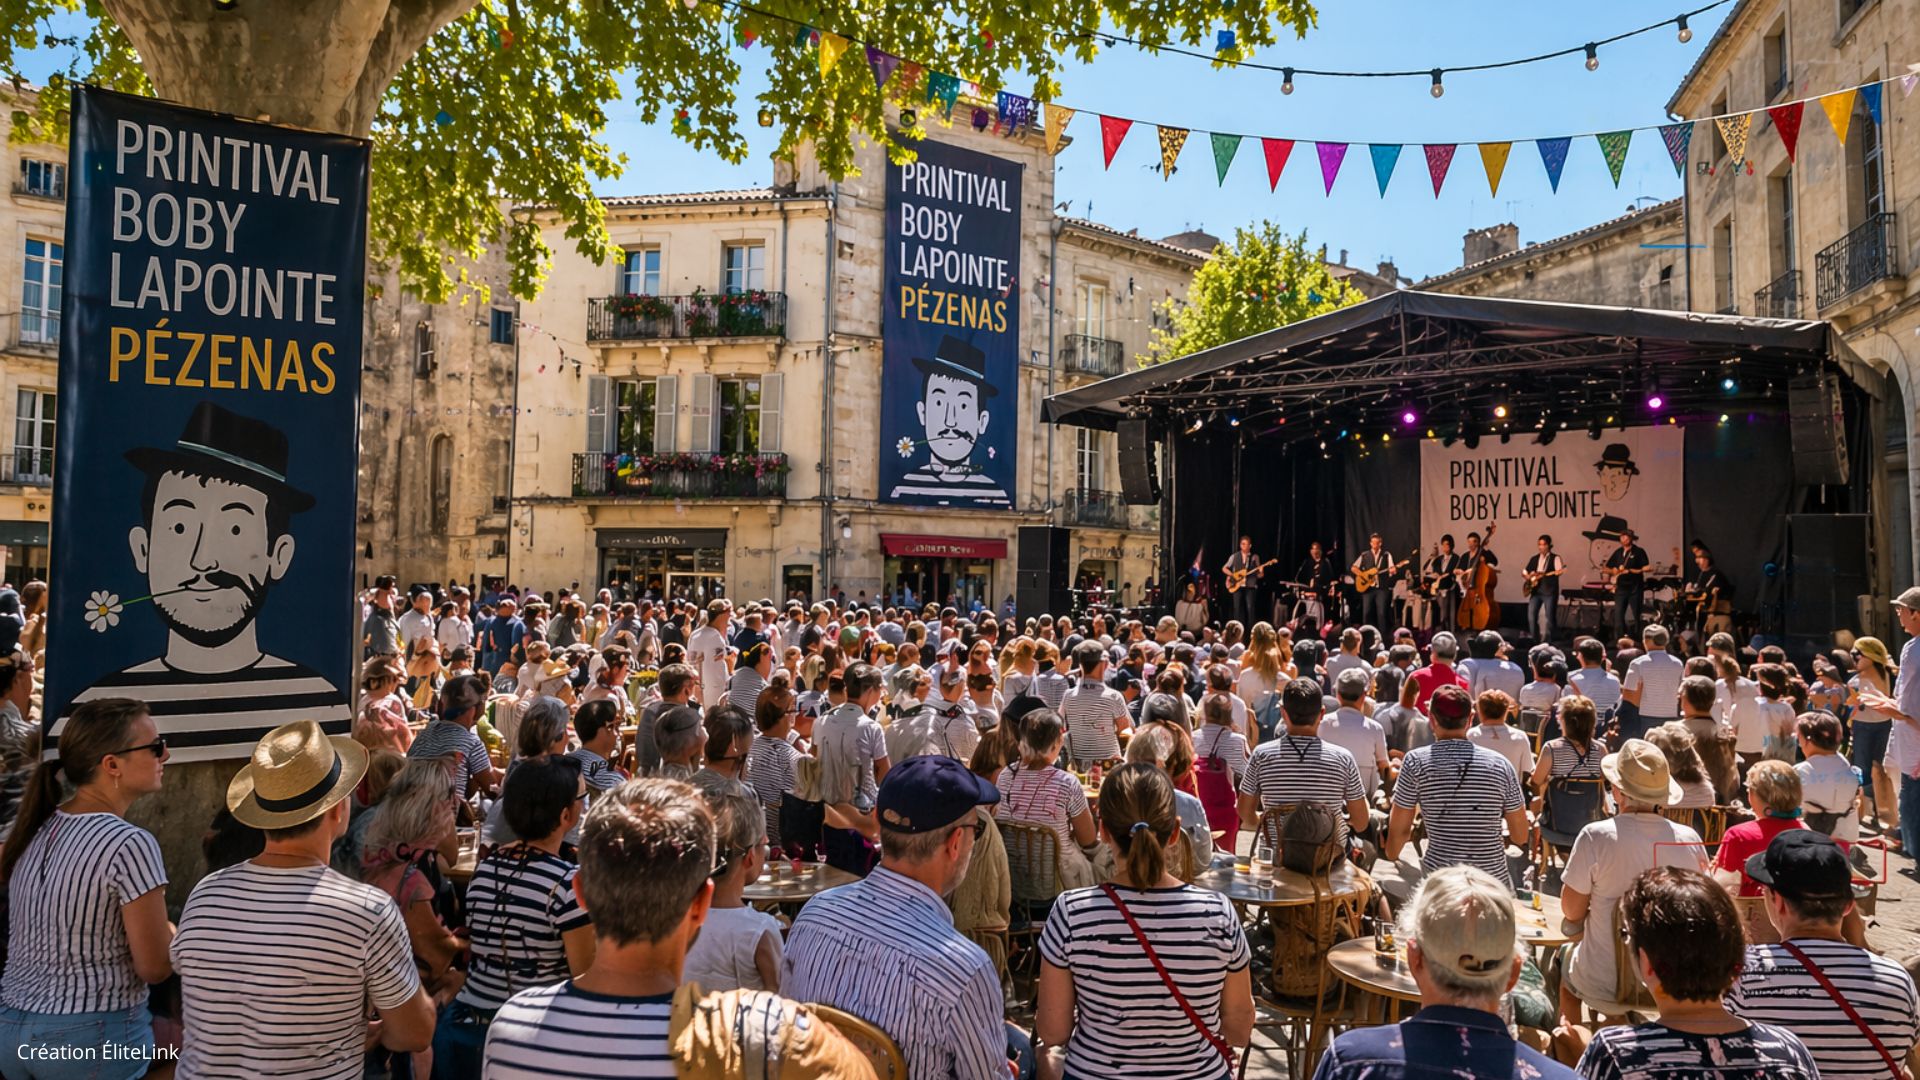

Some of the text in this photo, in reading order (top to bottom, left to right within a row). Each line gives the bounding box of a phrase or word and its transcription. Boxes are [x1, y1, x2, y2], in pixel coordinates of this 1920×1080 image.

[115, 119, 340, 205] PRINTIVAL
[901, 161, 1012, 213] PRINTIVAL
[113, 186, 247, 254] BOBY
[900, 202, 963, 245] BOBY
[110, 252, 337, 326] LAPOINTE
[900, 241, 1009, 292] LAPOINTE
[900, 281, 1008, 333] PÉZENAS
[108, 317, 337, 395] PÉZENAS
[1450, 456, 1564, 489] PRINTIVAL
[1450, 490, 1602, 521] BOBY LAPOINTE
